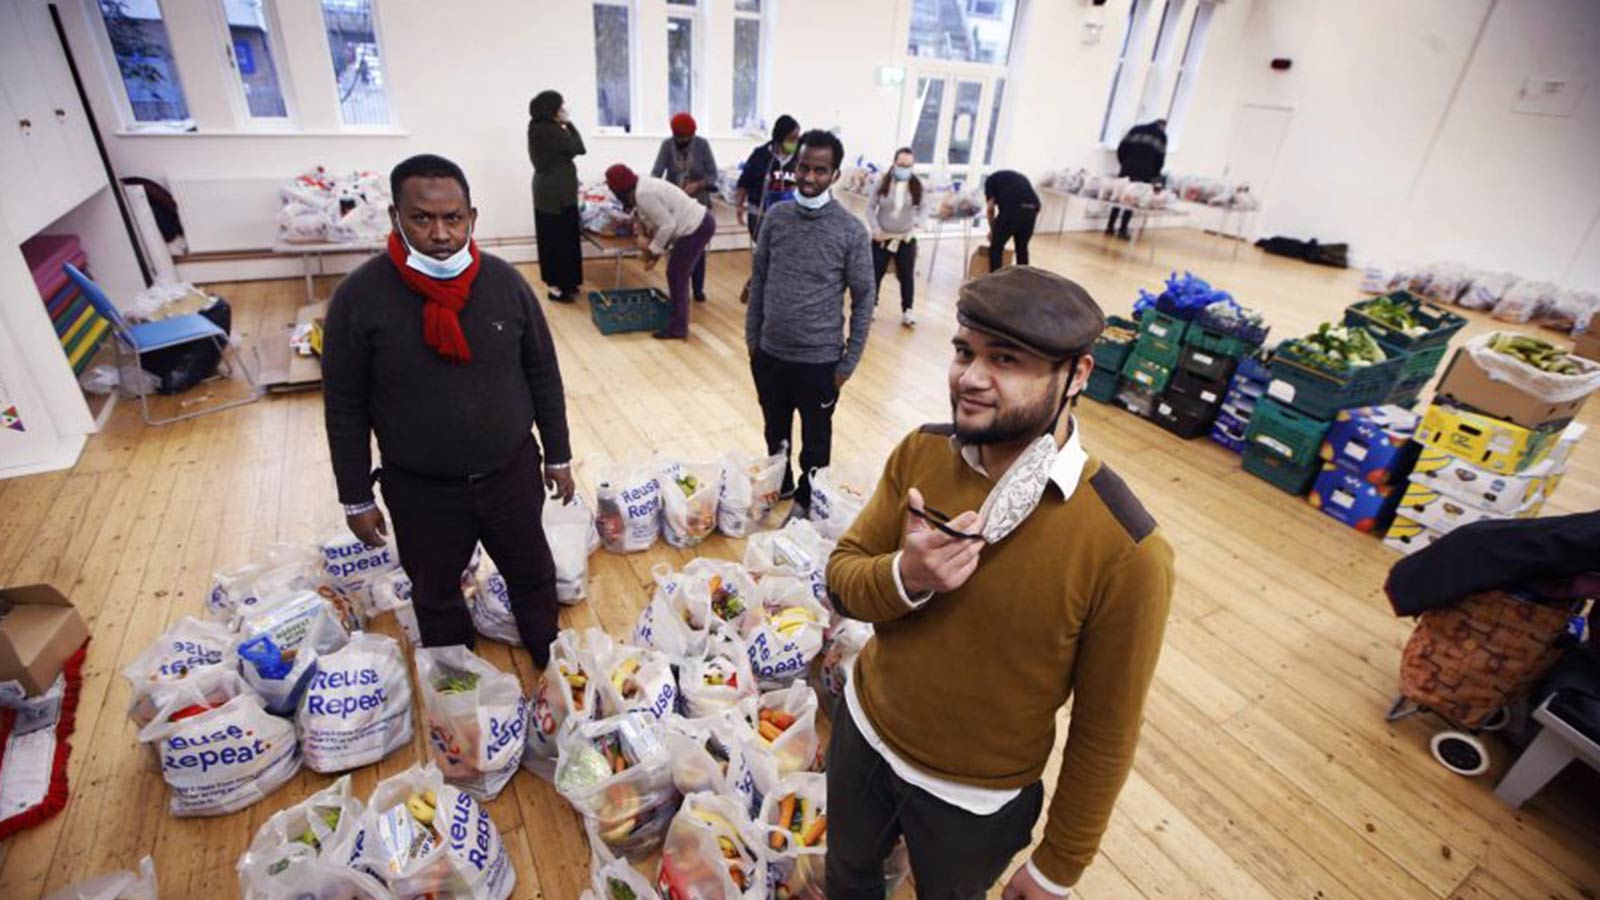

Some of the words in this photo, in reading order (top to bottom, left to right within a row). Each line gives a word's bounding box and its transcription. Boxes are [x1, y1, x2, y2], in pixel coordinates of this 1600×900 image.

[323, 541, 376, 560] euse
[325, 549, 391, 577] epeat
[169, 725, 253, 750] euse.
